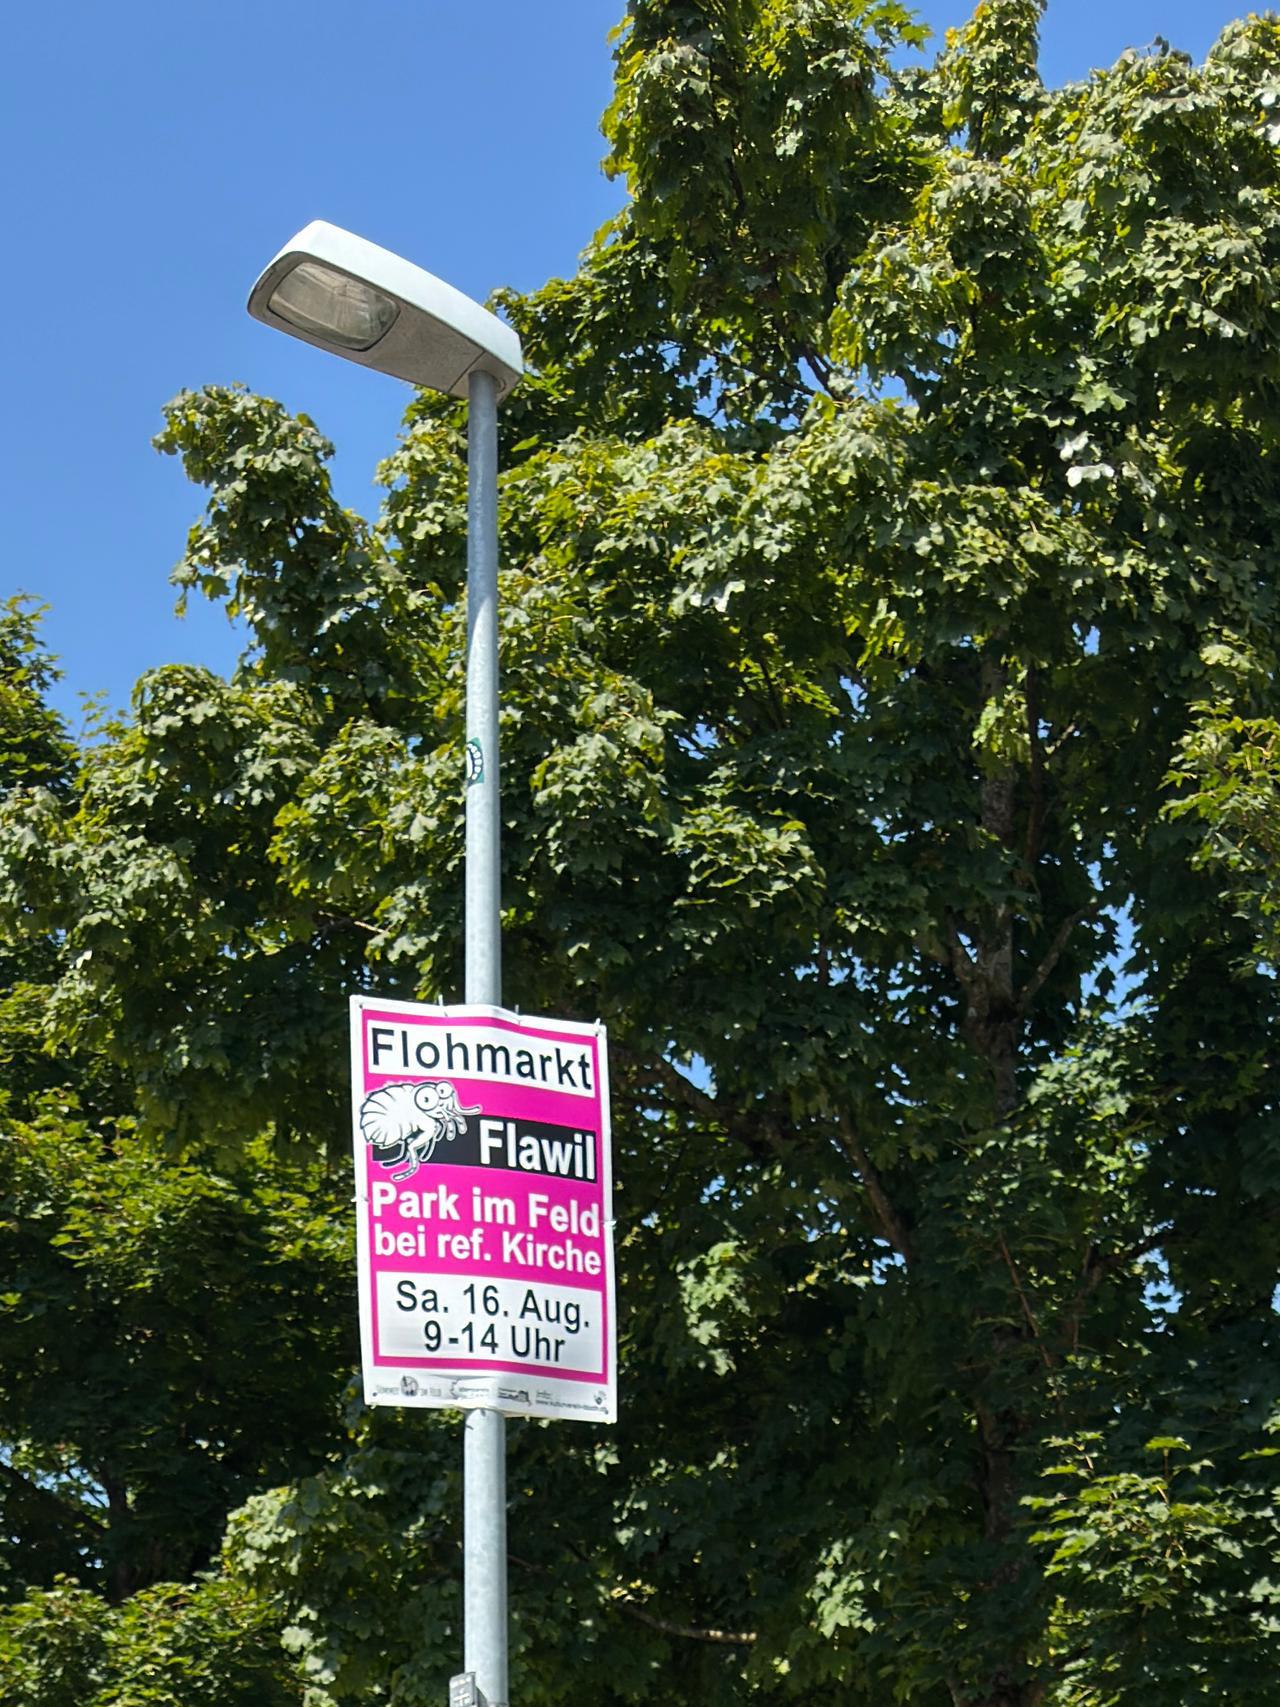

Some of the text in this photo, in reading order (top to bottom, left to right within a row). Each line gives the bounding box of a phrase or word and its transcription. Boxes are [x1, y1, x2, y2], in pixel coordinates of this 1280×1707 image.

[371, 1027, 593, 1091] Flohmarkt
[479, 1120, 596, 1181] Flawil
[372, 1181, 600, 1238] Park im Feld
[375, 1225, 602, 1275] bei ref. Kirche
[396, 1280, 591, 1335] Sa. 16. Aug.
[510, 1325, 565, 1363] Uhr
